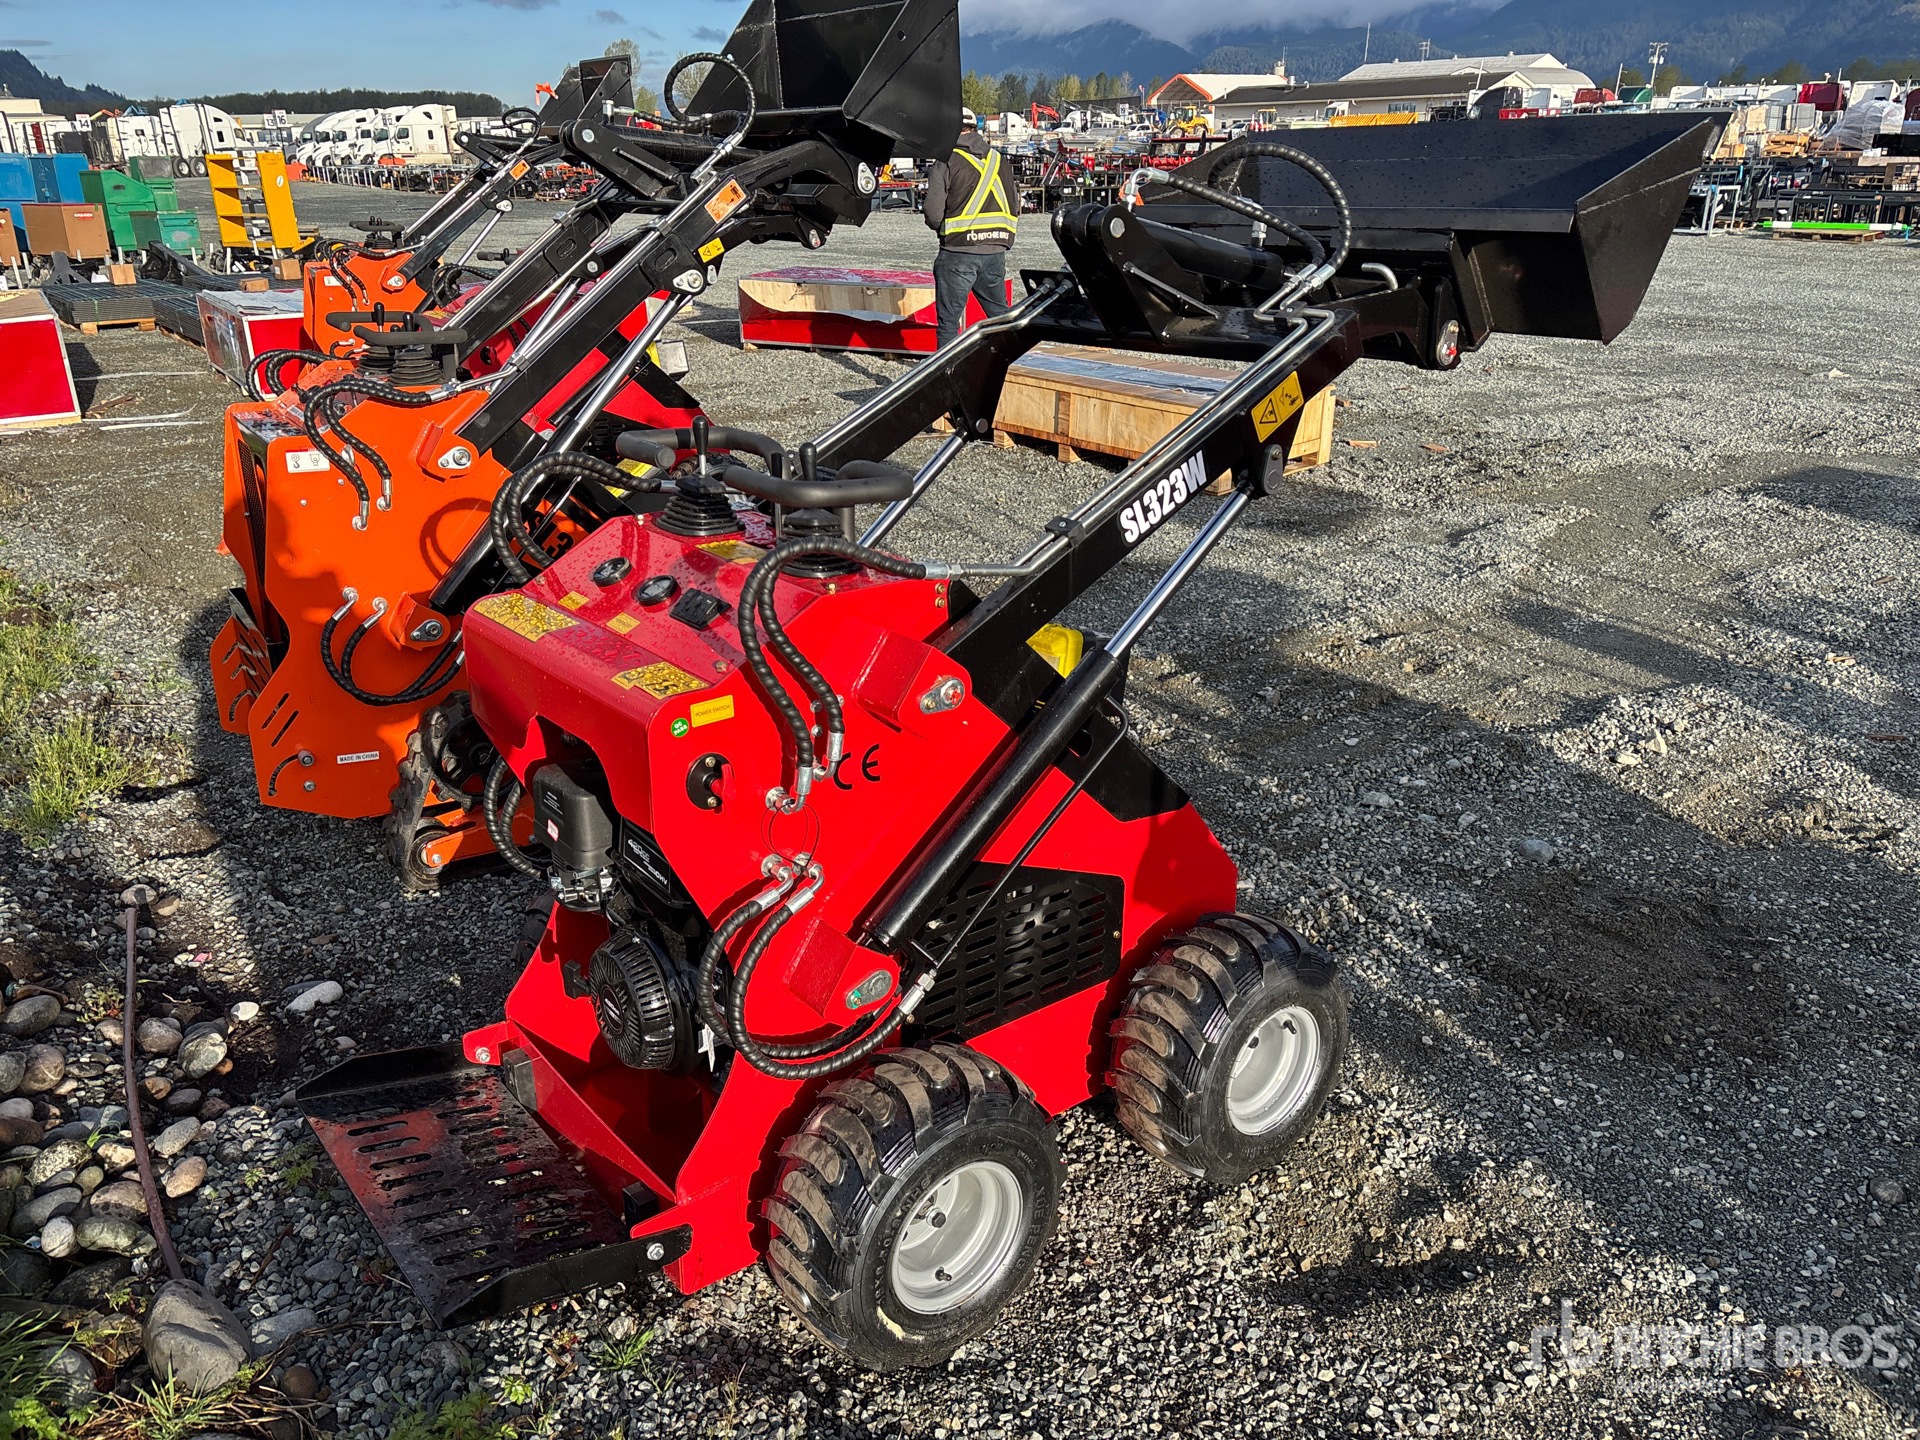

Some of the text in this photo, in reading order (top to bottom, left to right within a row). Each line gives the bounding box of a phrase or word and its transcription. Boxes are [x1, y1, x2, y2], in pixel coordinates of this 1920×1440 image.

[78, 119, 90, 128] 14
[277, 115, 286, 124] 16
[1119, 450, 1207, 543] SL323W
[695, 704, 730, 717] POWER SWITCH
[674, 721, 682, 729] QC
[674, 724, 688, 735] PASS
